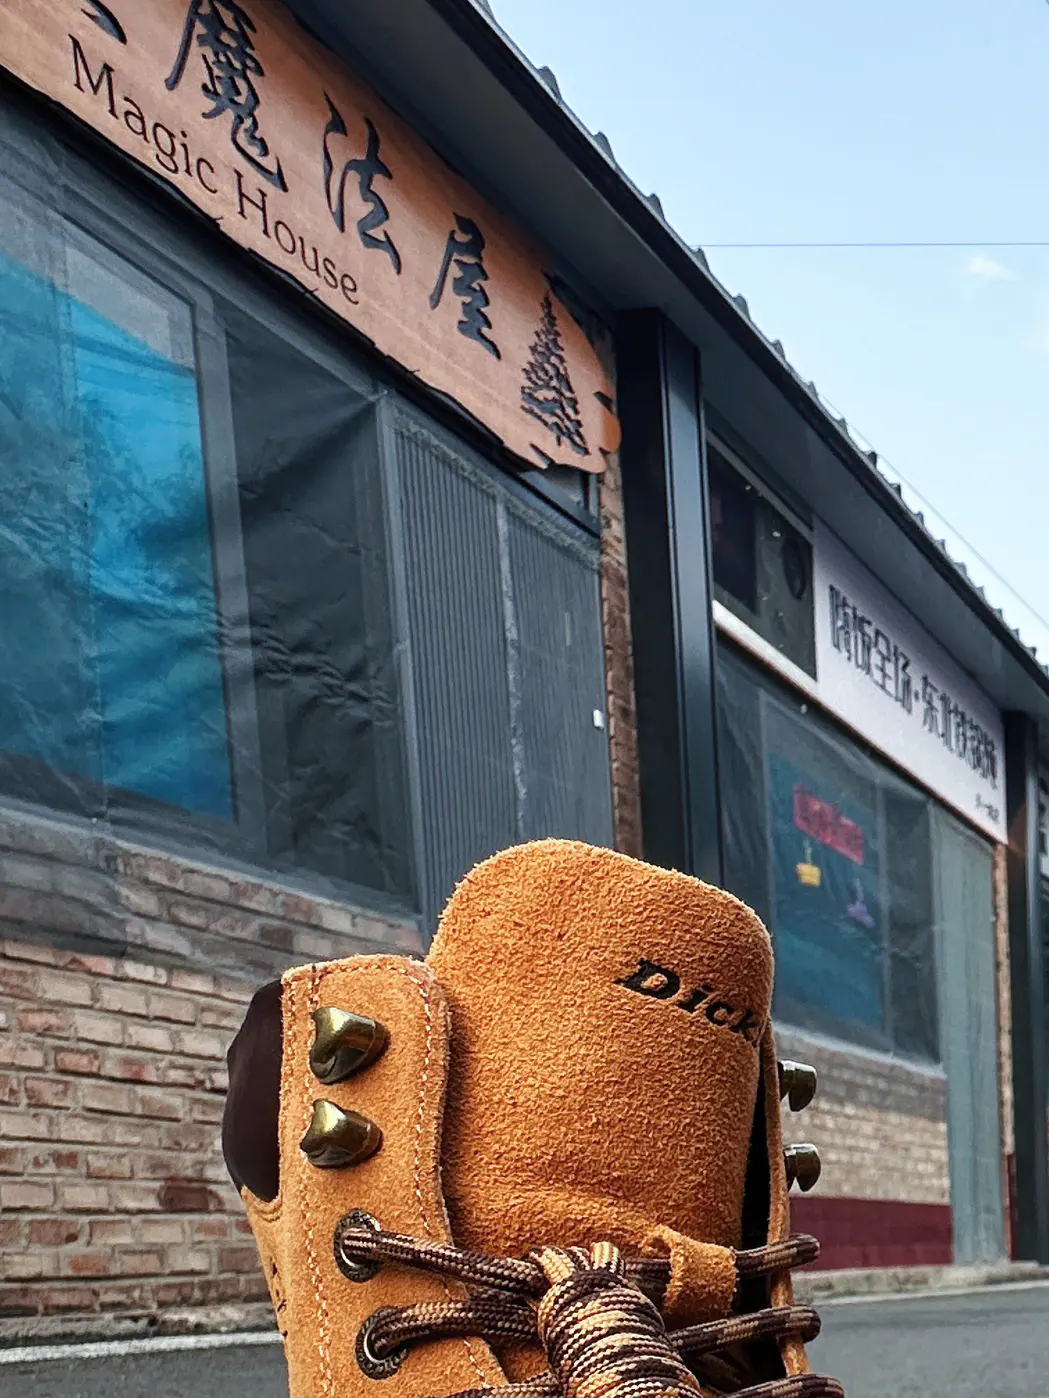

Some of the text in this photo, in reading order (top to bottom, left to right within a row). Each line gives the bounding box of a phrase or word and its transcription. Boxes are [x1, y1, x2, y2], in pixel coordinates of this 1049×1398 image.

[68, 33, 360, 305] Magic House
[81, 0, 501, 360] 魔法屋
[613, 957, 758, 1047] Dick
